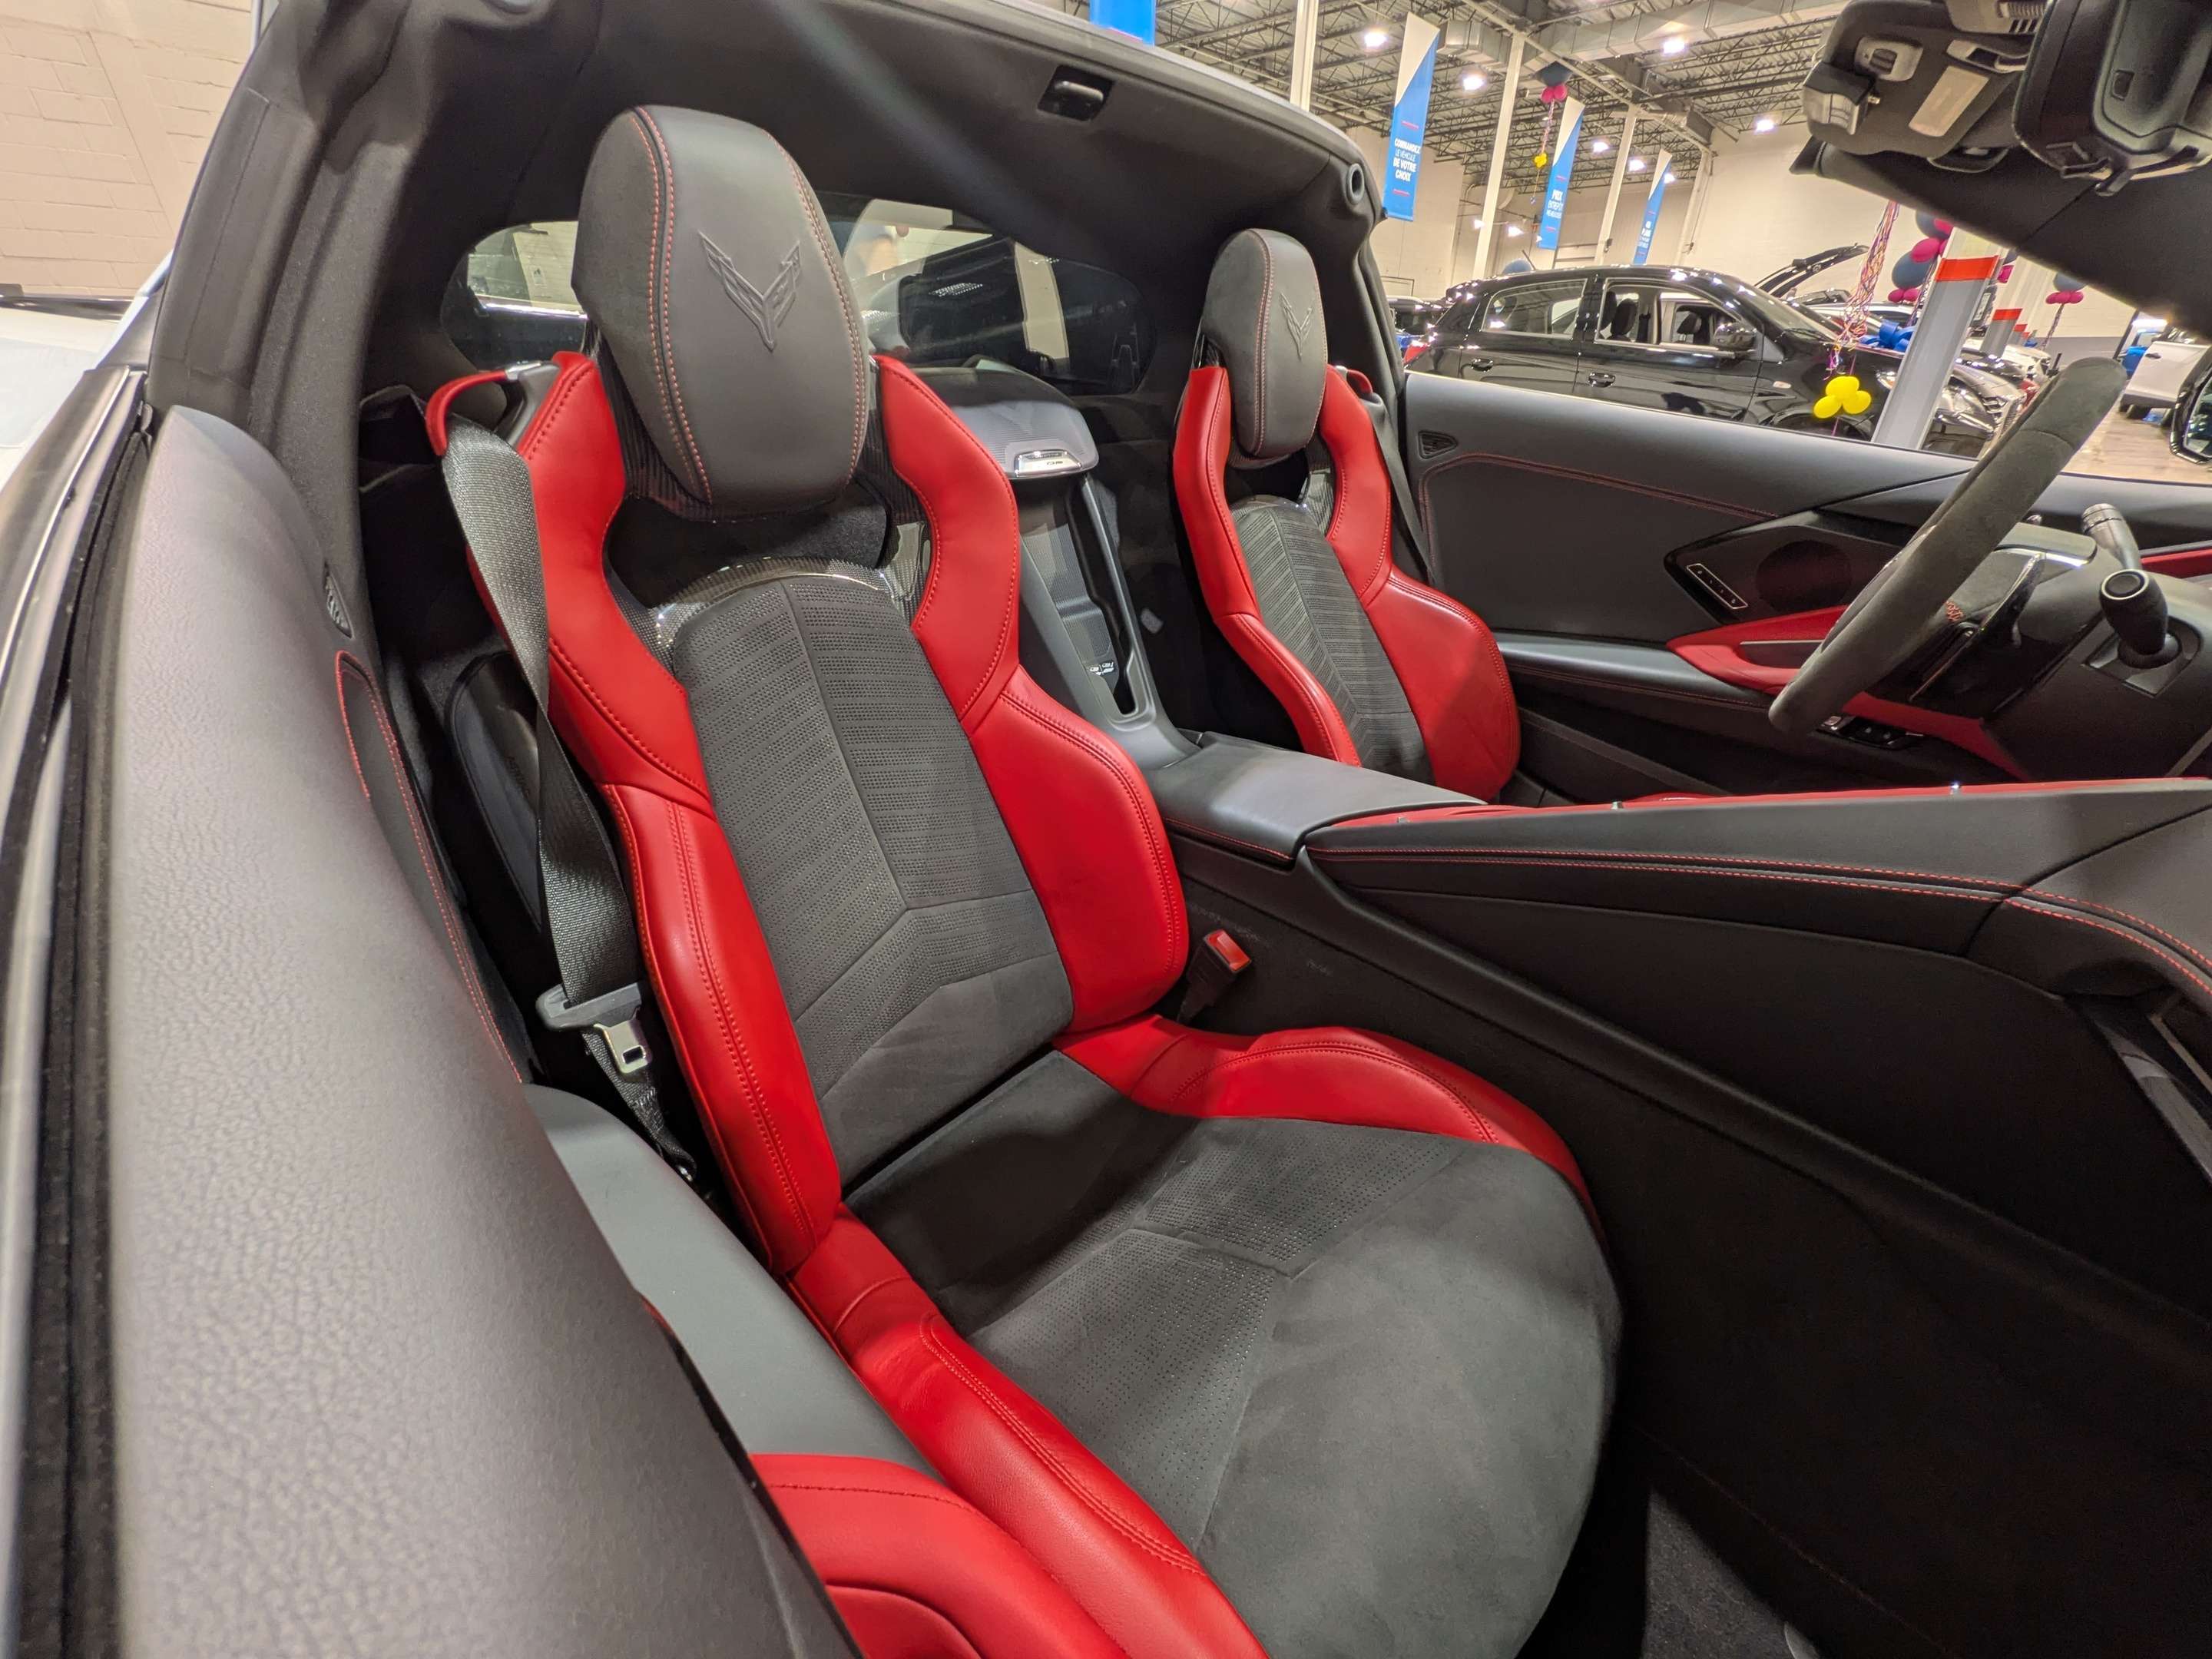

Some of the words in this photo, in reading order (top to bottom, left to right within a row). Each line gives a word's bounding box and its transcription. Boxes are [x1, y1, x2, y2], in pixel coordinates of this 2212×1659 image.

[1393, 157, 1400, 167] DE
[1400, 159, 1417, 172] VOTRE
[1395, 169, 1412, 181] CHOIX
